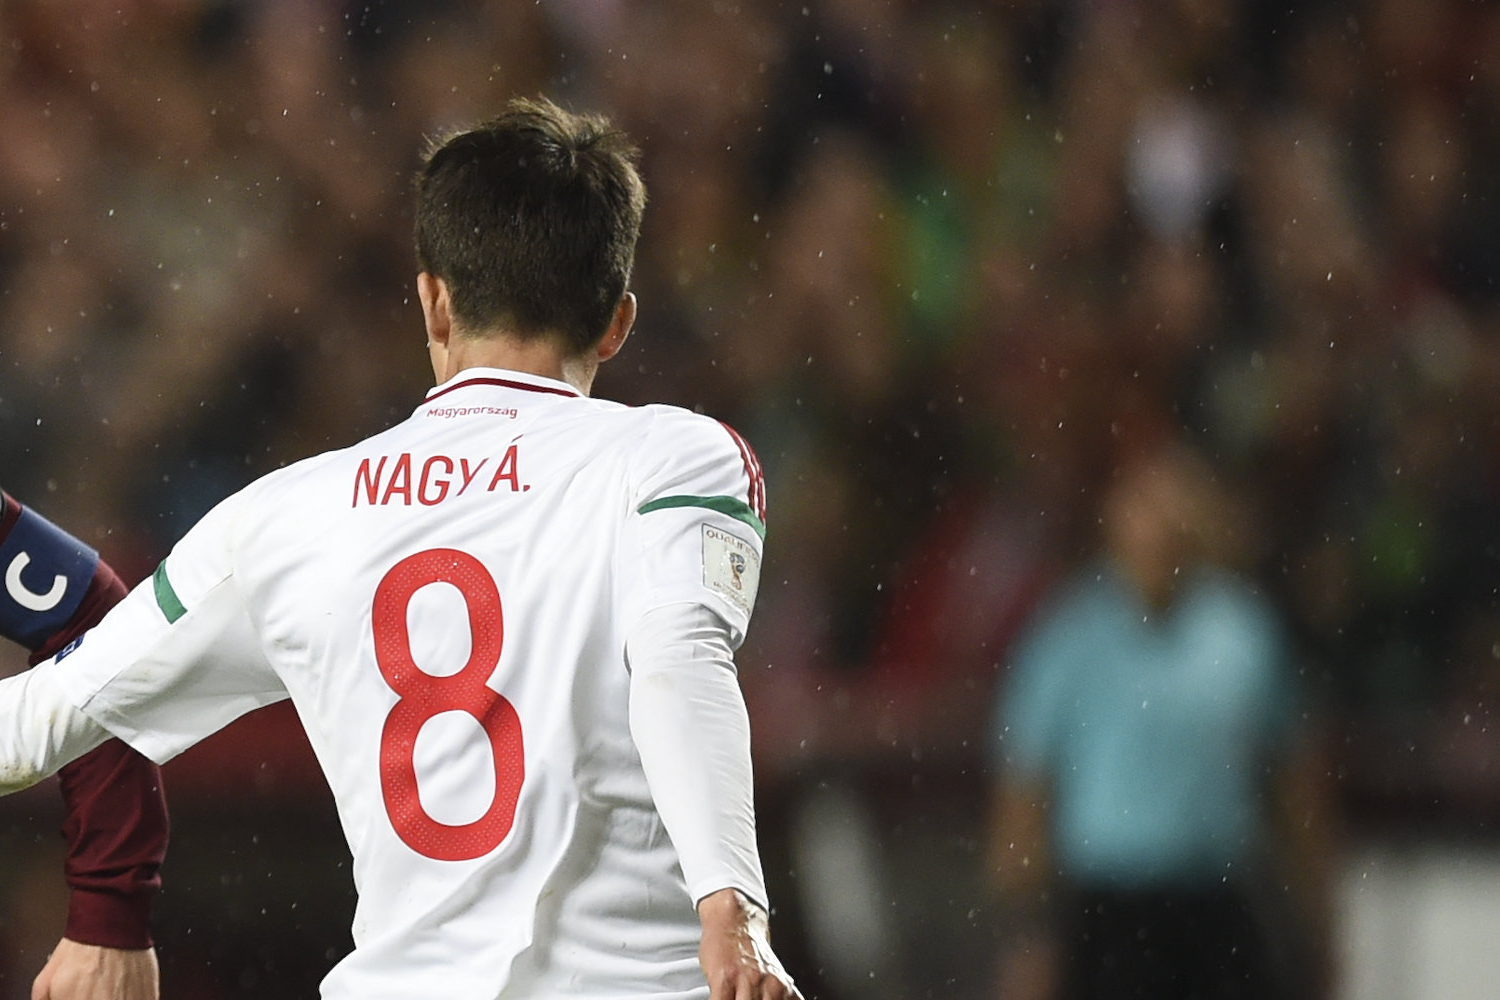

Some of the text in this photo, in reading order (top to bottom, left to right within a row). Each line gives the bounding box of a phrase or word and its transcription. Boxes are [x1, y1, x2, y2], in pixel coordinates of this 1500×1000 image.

[426, 406, 518, 419] Magyarország
[352, 453, 490, 508] NAGY
[5, 551, 68, 612] C
[372, 548, 525, 861] 8
